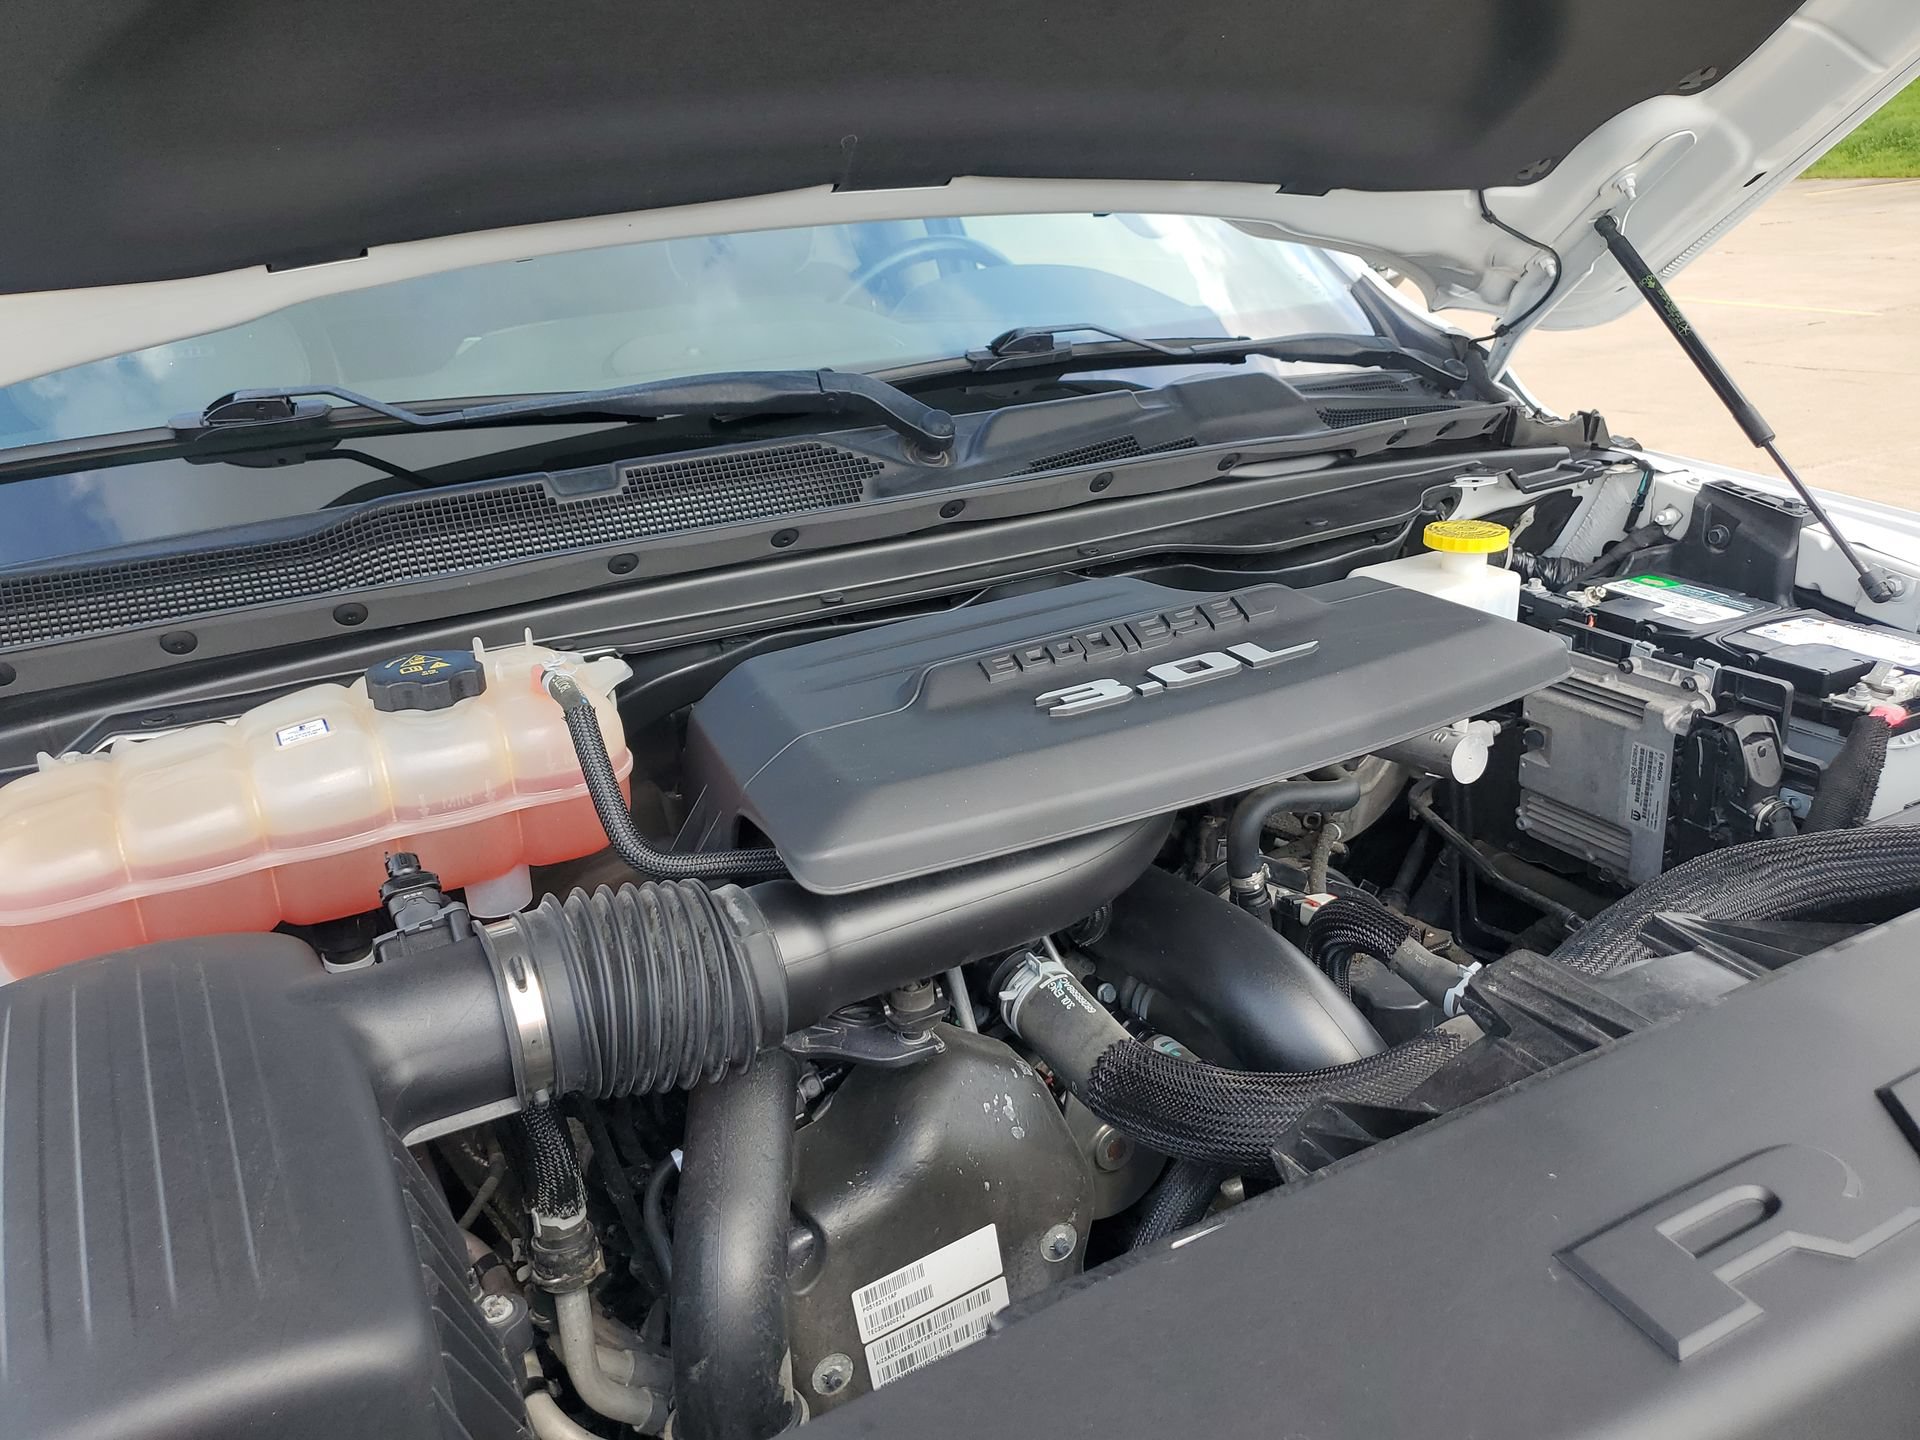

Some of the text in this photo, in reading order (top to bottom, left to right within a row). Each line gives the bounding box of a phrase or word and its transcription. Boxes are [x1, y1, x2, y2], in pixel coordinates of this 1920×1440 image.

[978, 594, 1277, 682] ECODIESEL
[1034, 640, 1319, 717] 3.0L
[1048, 981, 1065, 998] ENG
